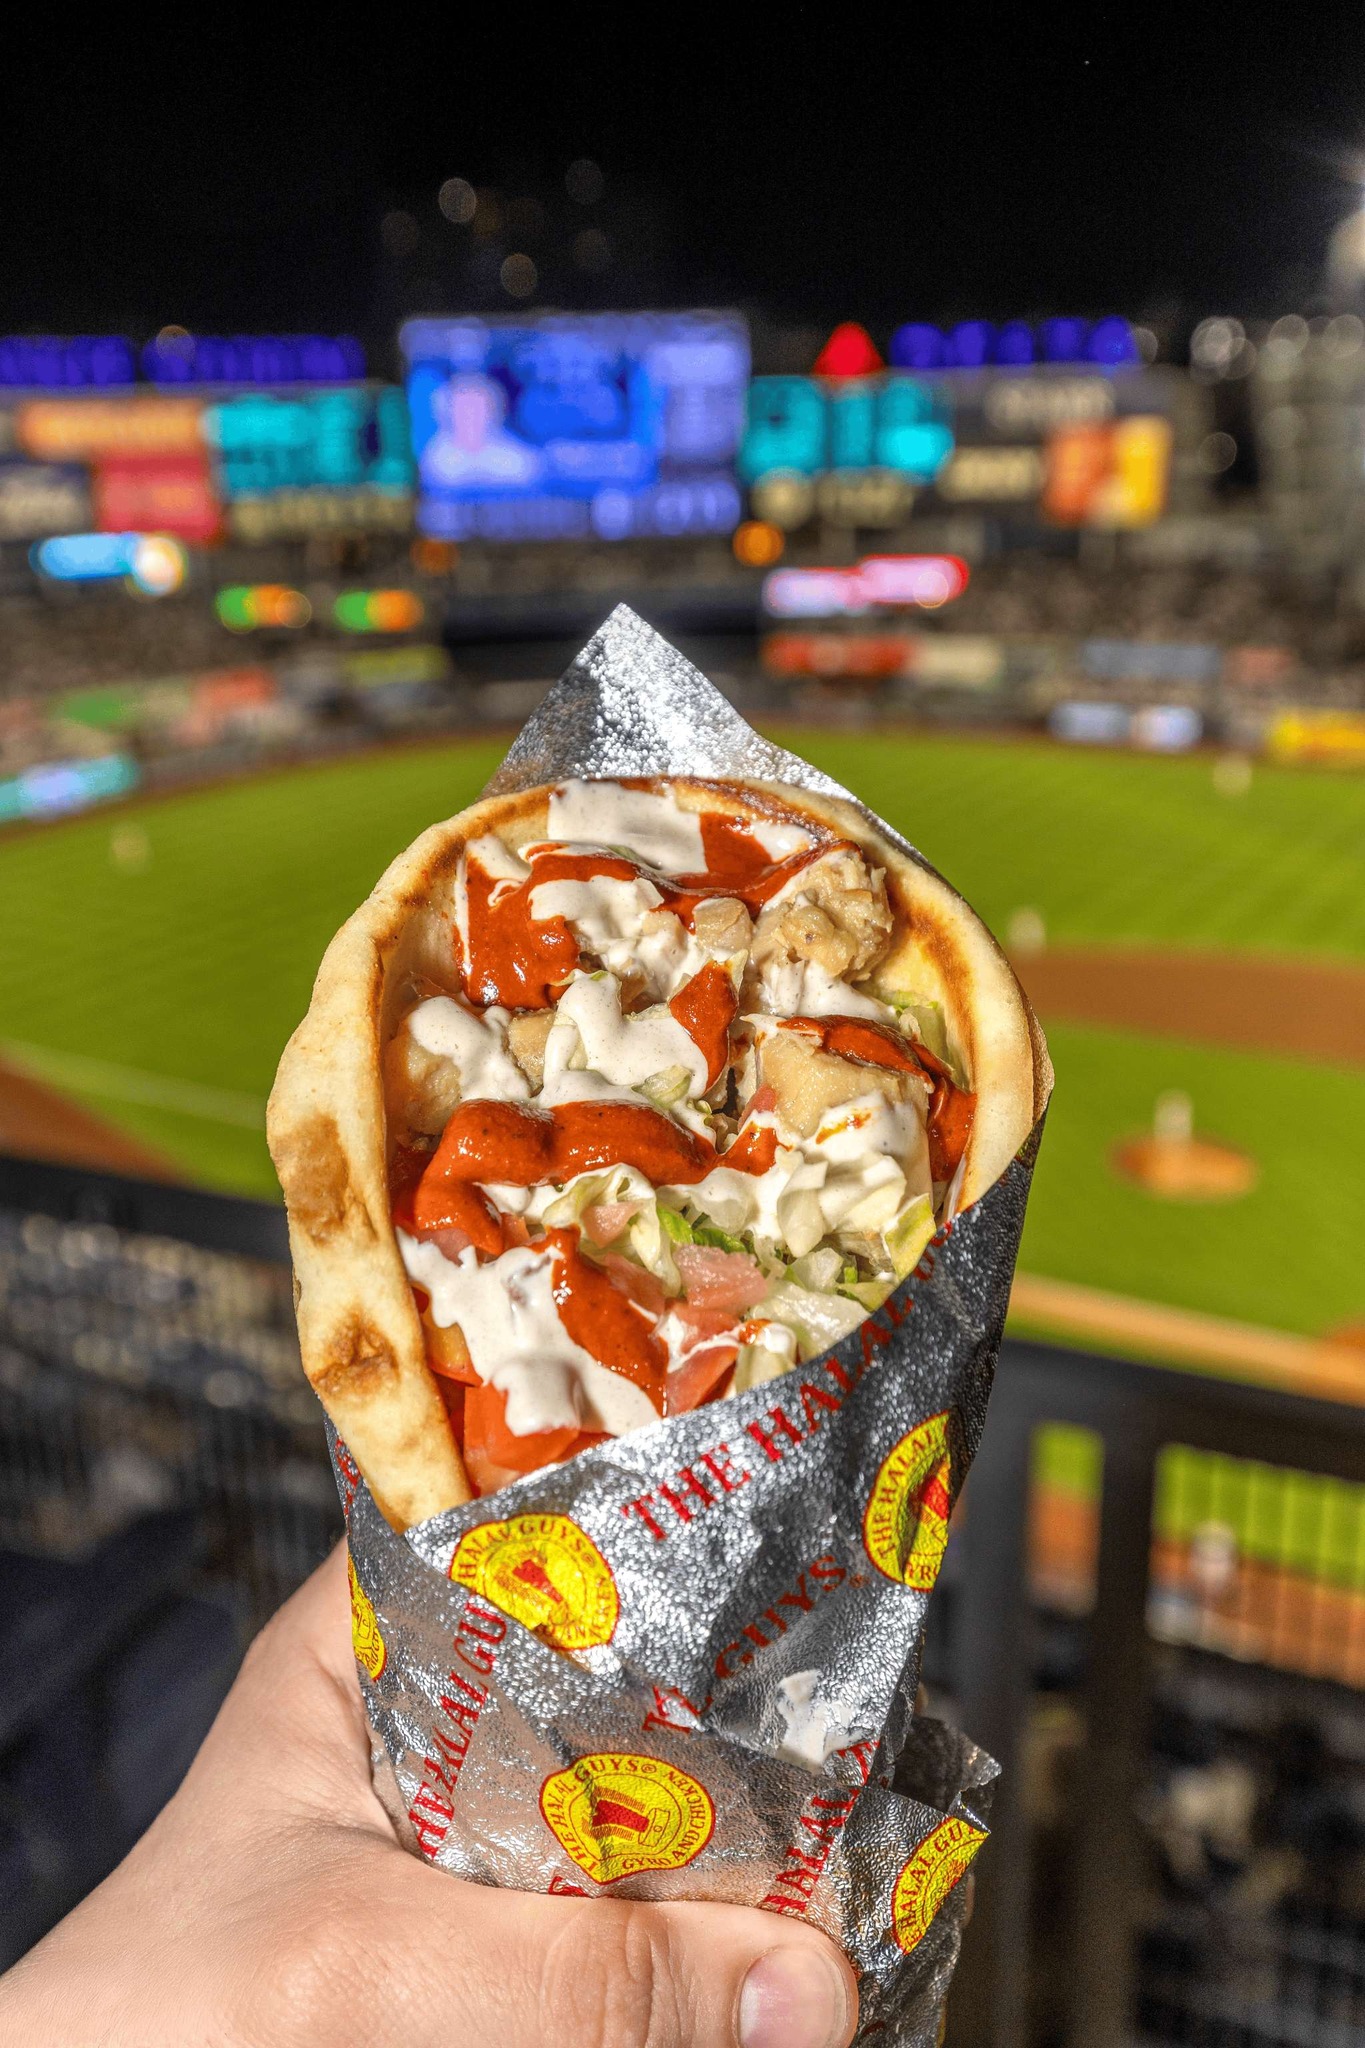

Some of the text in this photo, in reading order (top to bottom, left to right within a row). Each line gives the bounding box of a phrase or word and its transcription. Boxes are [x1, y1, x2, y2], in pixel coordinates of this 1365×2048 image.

[621, 1295, 914, 1542] THE HALAL
[872, 1510, 897, 1560] THE
[546, 1779, 578, 1829] HALAL
[663, 1769, 707, 1830] CHICKEN
[622, 1856, 673, 1871] GYRO
[671, 1829, 701, 1862] AND
